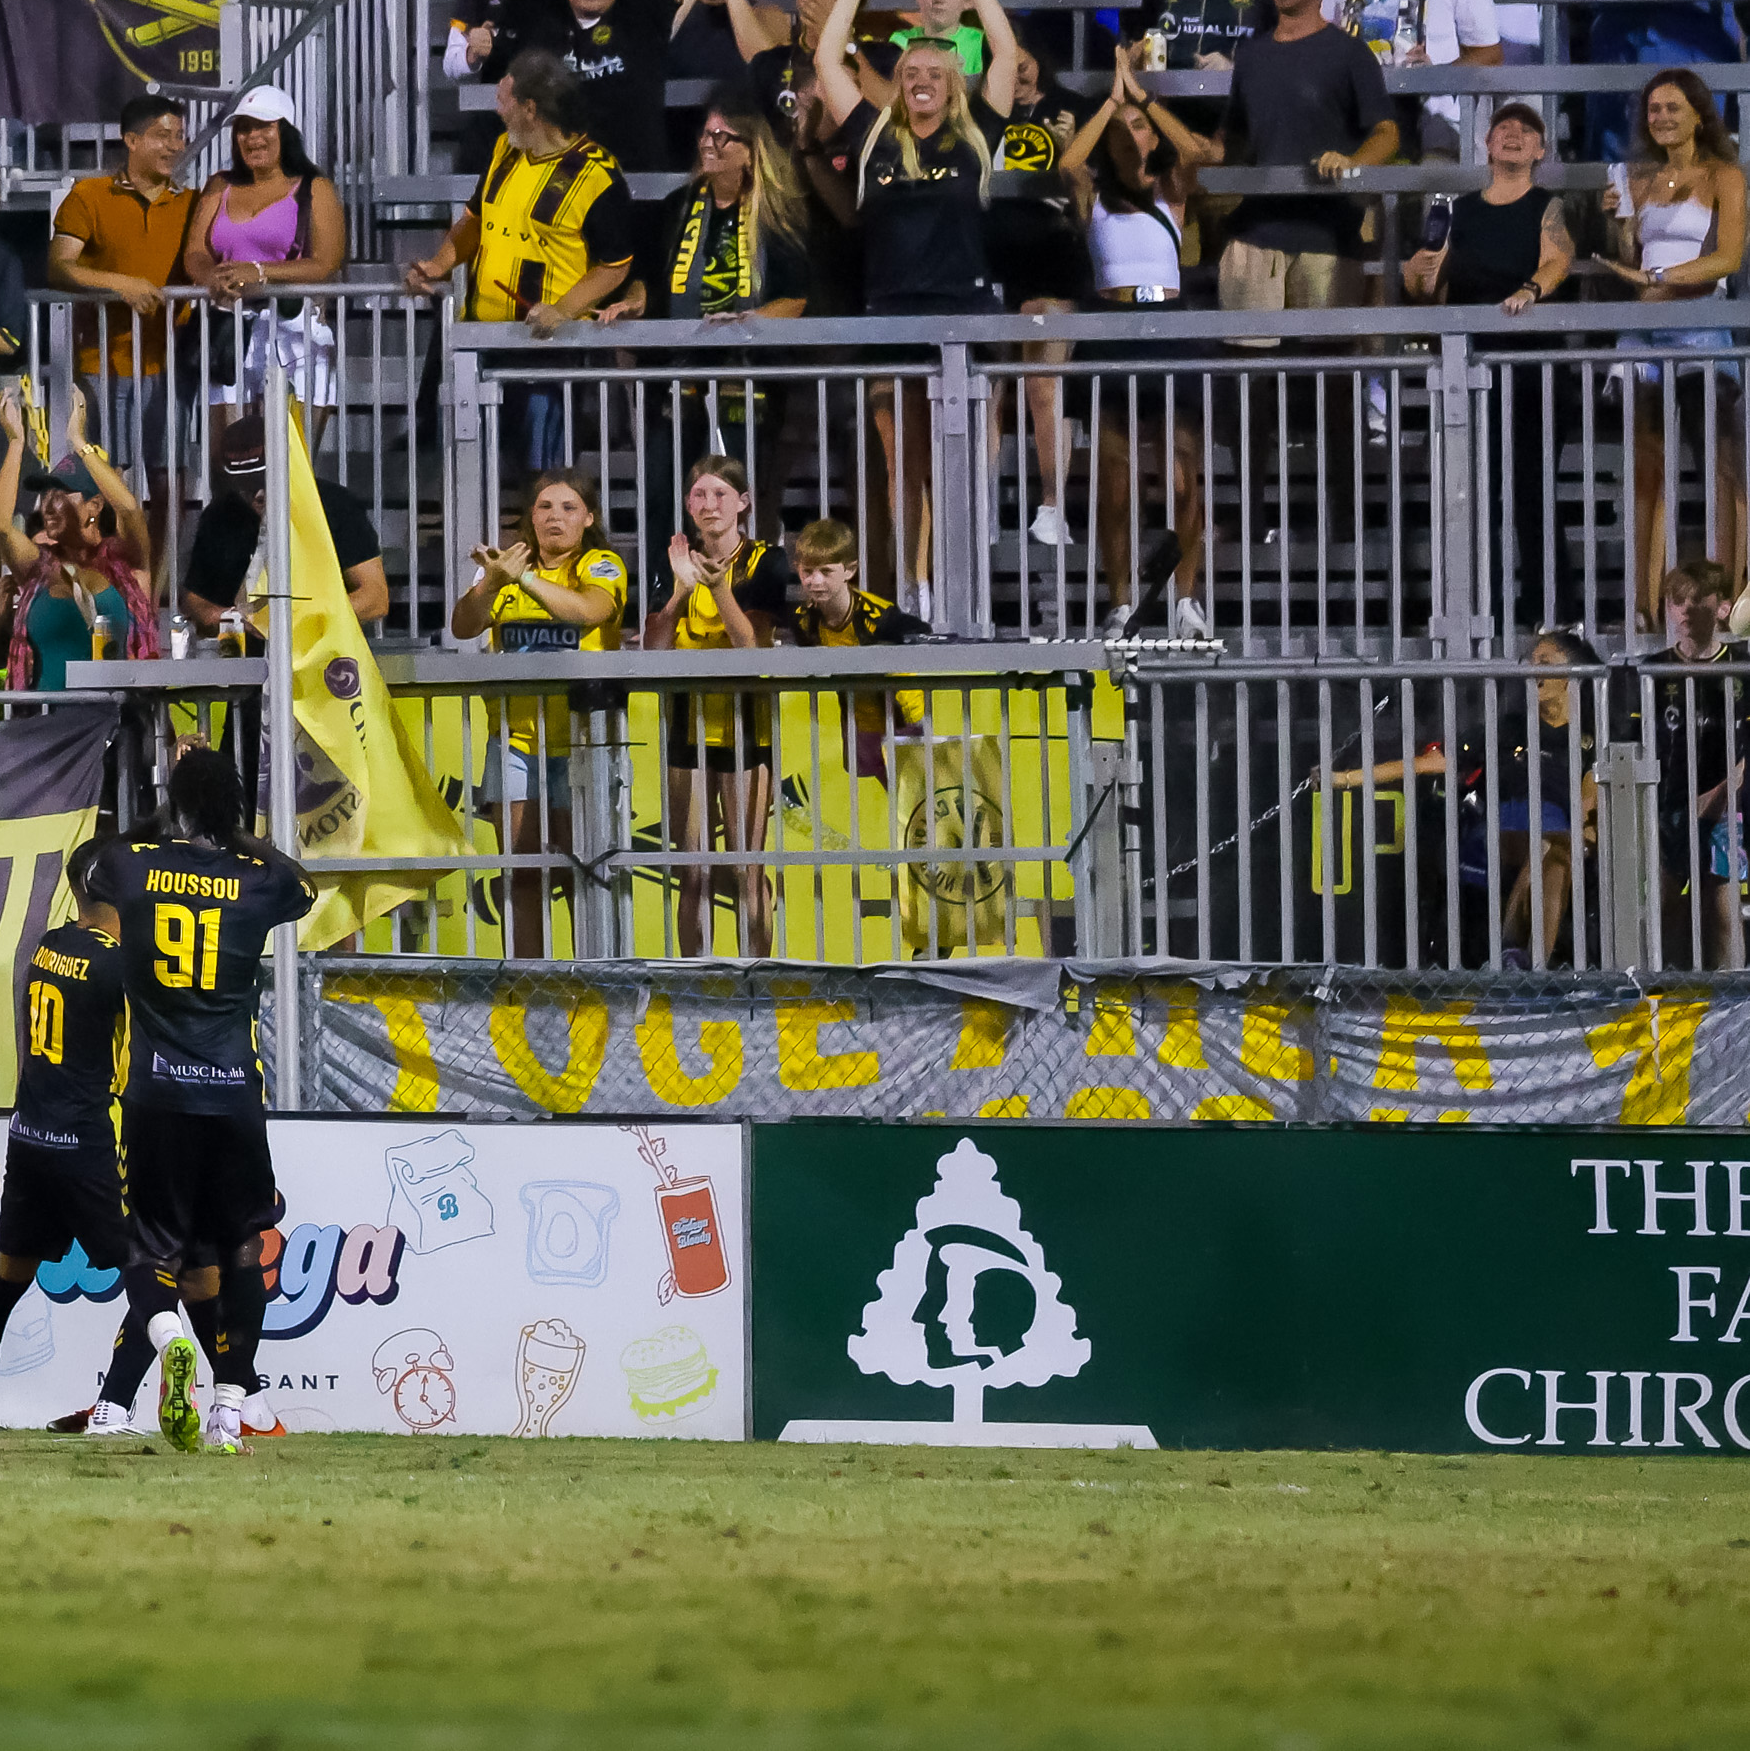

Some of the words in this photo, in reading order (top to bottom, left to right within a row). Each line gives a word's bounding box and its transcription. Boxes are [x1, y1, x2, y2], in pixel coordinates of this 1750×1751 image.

[180, 50, 220, 72] 199
[146, 869, 240, 901] HOUSSOU
[154, 904, 221, 990] 91
[29, 981, 64, 1064] 10
[169, 1065, 209, 1078] MUSC
[46, 1131, 79, 1144] Health
[438, 1193, 459, 1221] B
